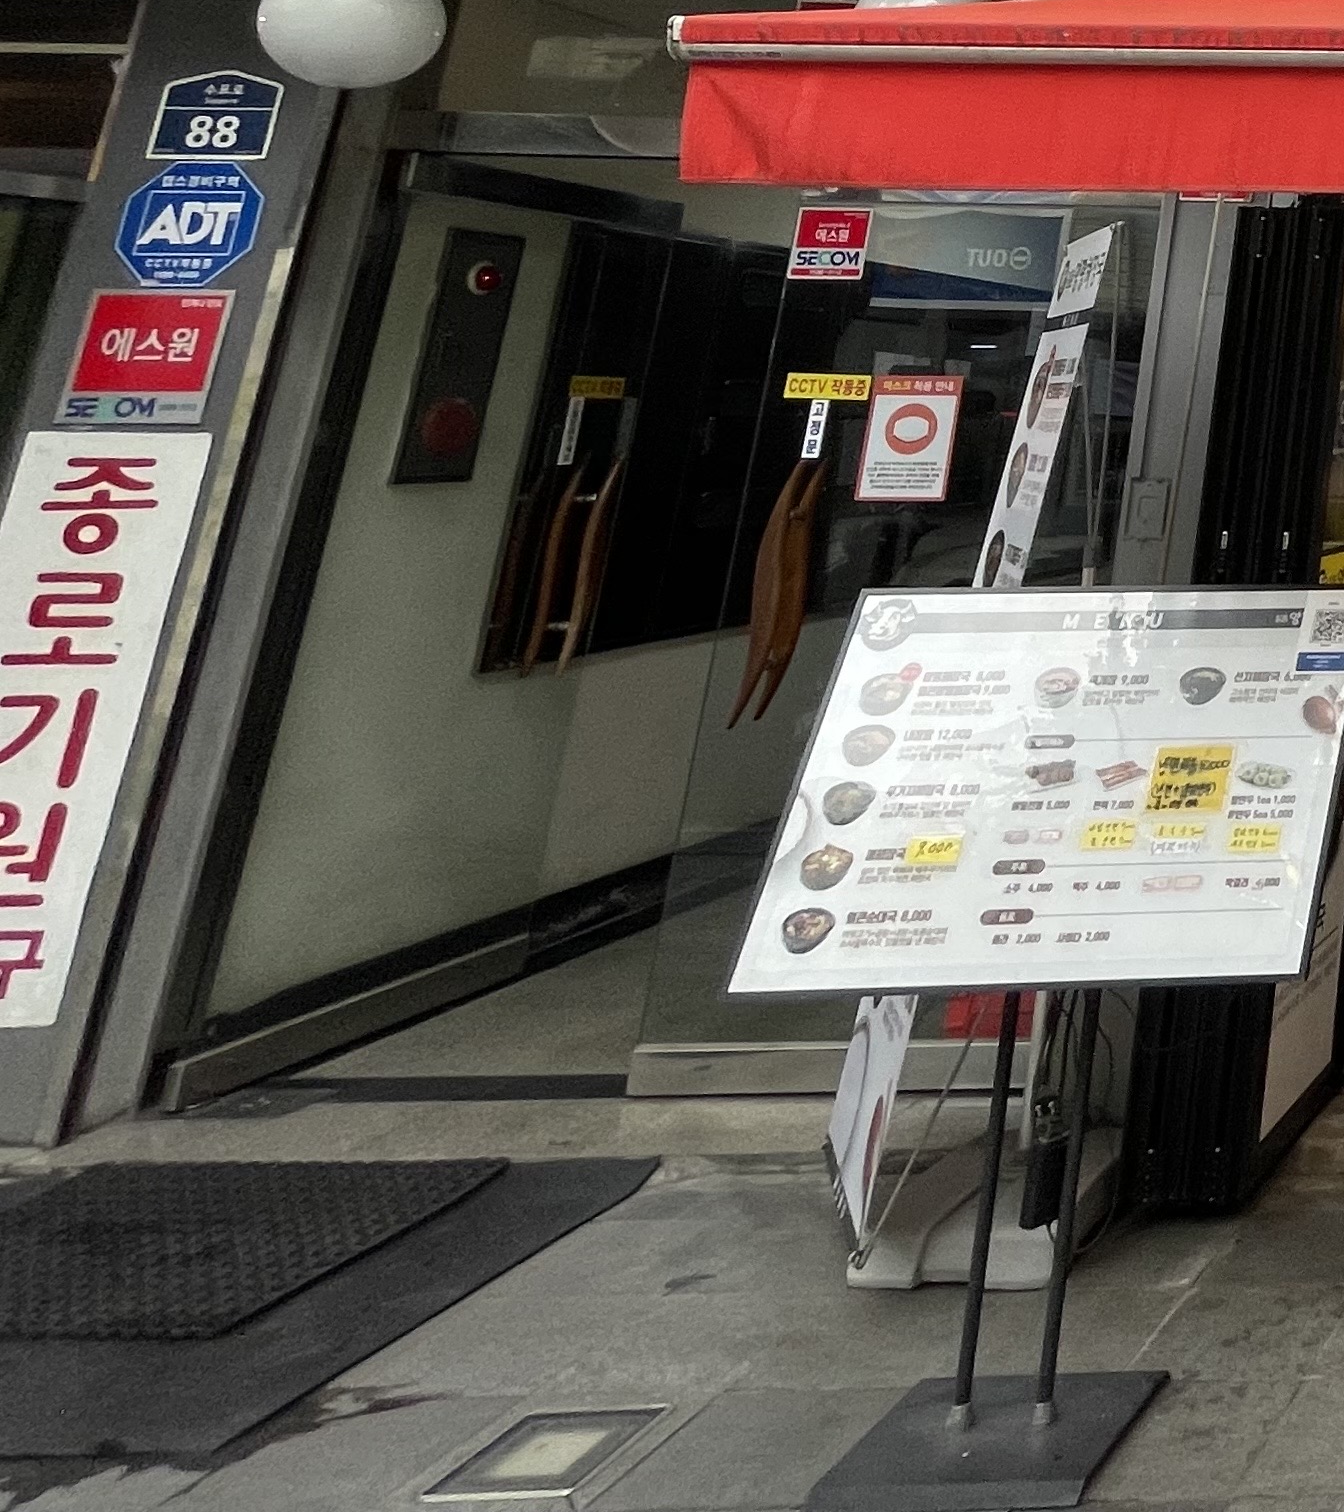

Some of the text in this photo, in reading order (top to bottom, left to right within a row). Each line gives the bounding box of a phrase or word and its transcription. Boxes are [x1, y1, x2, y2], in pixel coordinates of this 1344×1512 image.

[184, 114, 241, 149] 88
[136, 201, 244, 245] ADT
[795, 251, 861, 267] SECOM
[101, 326, 200, 363] 에스원
[788, 378, 828, 394] CCTV
